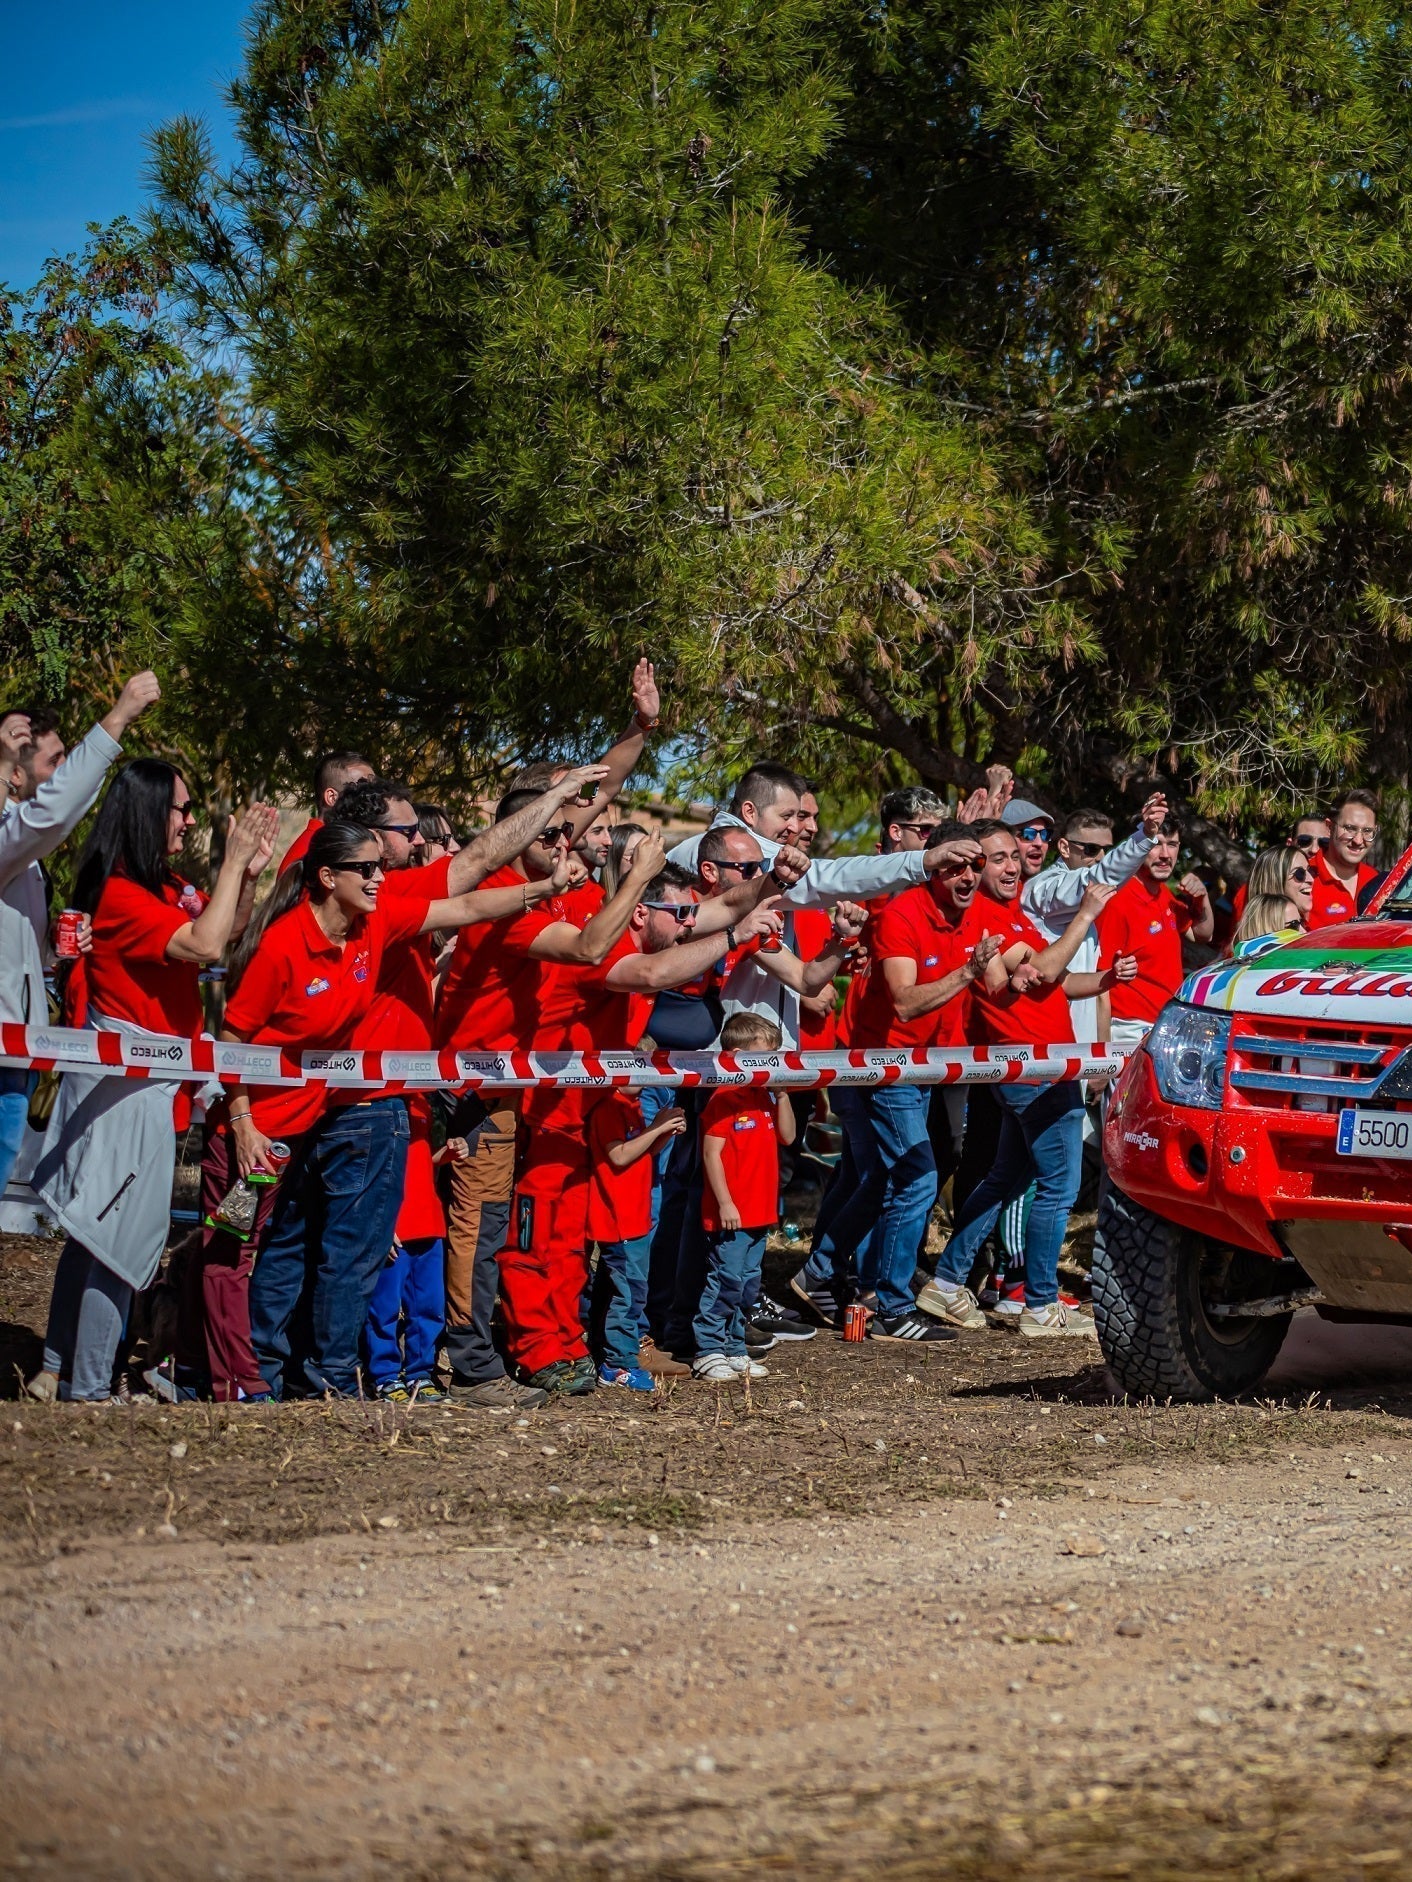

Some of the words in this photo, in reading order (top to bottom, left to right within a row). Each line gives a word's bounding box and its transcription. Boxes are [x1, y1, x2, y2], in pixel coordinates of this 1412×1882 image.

[130, 1046, 168, 1059] HITECO
[310, 1059, 342, 1071] HITECO
[464, 1060, 494, 1071] HITECO
[607, 1060, 636, 1069] HITECO
[742, 1058, 770, 1067] HITECO
[871, 1057, 897, 1066] HITECO
[706, 1074, 735, 1085] HITECO
[839, 1073, 868, 1082] HITECO
[1358, 1119, 1409, 1149] 5500
[1342, 1136, 1350, 1146] E
